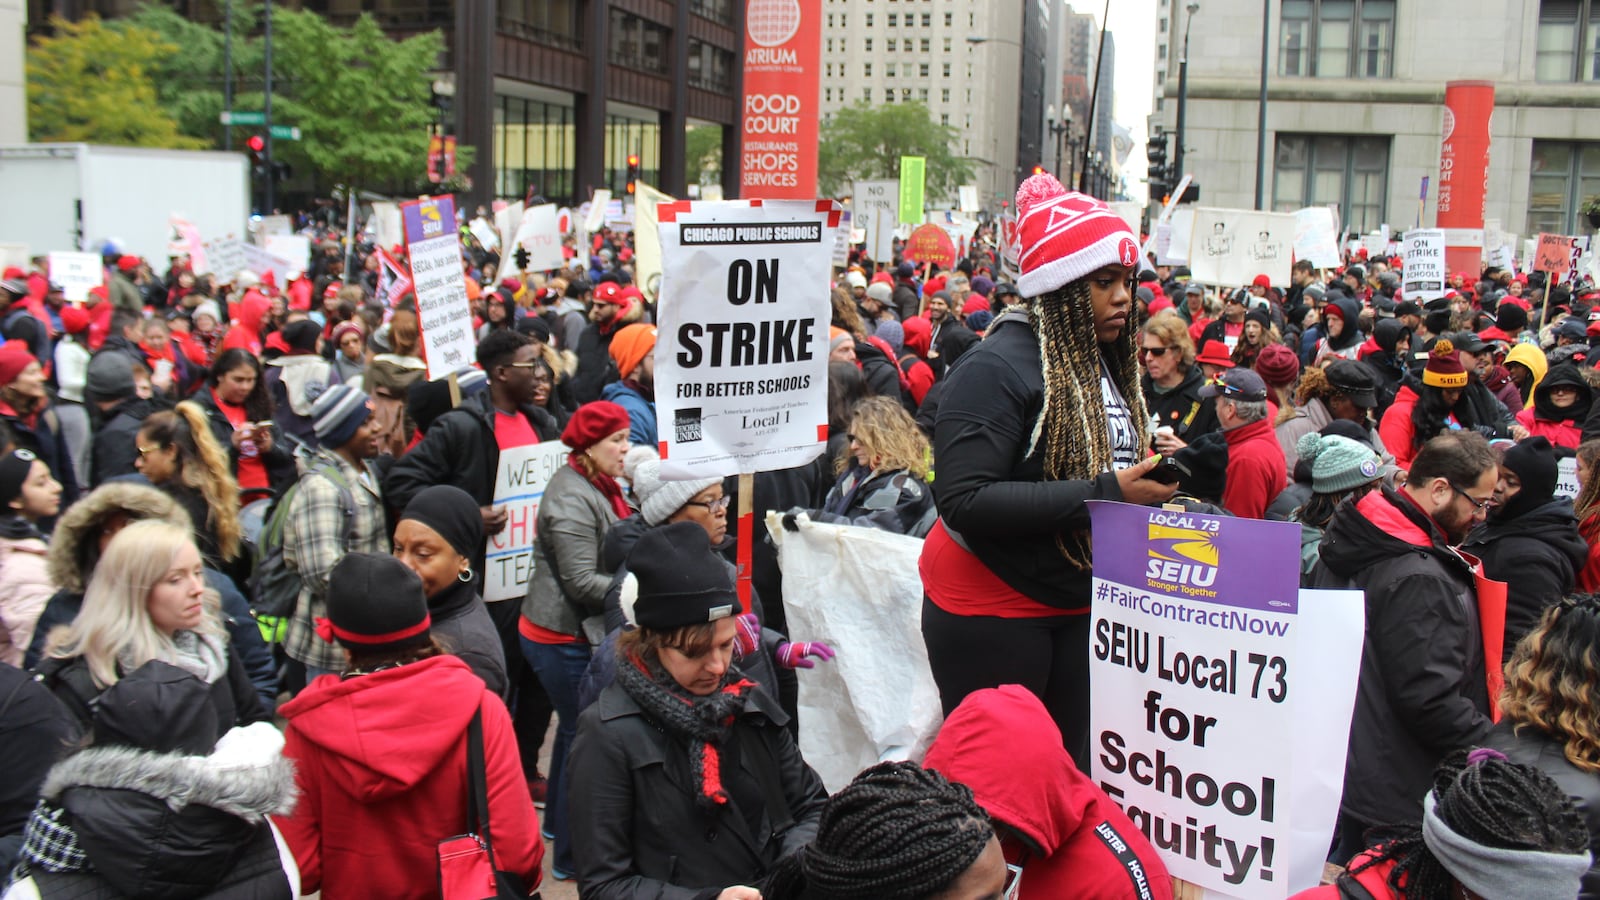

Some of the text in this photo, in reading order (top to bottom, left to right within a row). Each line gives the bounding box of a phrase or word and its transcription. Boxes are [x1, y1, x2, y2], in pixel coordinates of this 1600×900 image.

[745, 48, 798, 64] ATRIUM
[745, 94, 801, 114] FOOD
[745, 116, 800, 134] COURT
[744, 153, 798, 171] SHOPS
[744, 172, 798, 187] SERVICES
[868, 186, 884, 196] NO
[683, 226, 818, 242] CHICAGO PUBLIC SCHOOLS
[1407, 248, 1440, 259] STRIKE
[1413, 240, 1428, 249] ON
[1406, 271, 1440, 279] SCHOOLS
[1408, 263, 1436, 271] BETTER
[727, 258, 779, 306] ON
[677, 318, 815, 368] STRIKE
[677, 375, 811, 398] FOR BETTER SCHOOLS
[741, 410, 791, 430] Local 1
[676, 431, 702, 441] UNION
[508, 458, 537, 488] WE
[1149, 512, 1220, 532] LOCAL 73
[1145, 559, 1218, 587] SEIU
[1147, 579, 1217, 598] Stronger Together
[1096, 582, 1290, 637] #FairContractNow
[1094, 618, 1288, 704] SEIU Local 73
[1143, 690, 1218, 748] for
[1100, 730, 1275, 823] School
